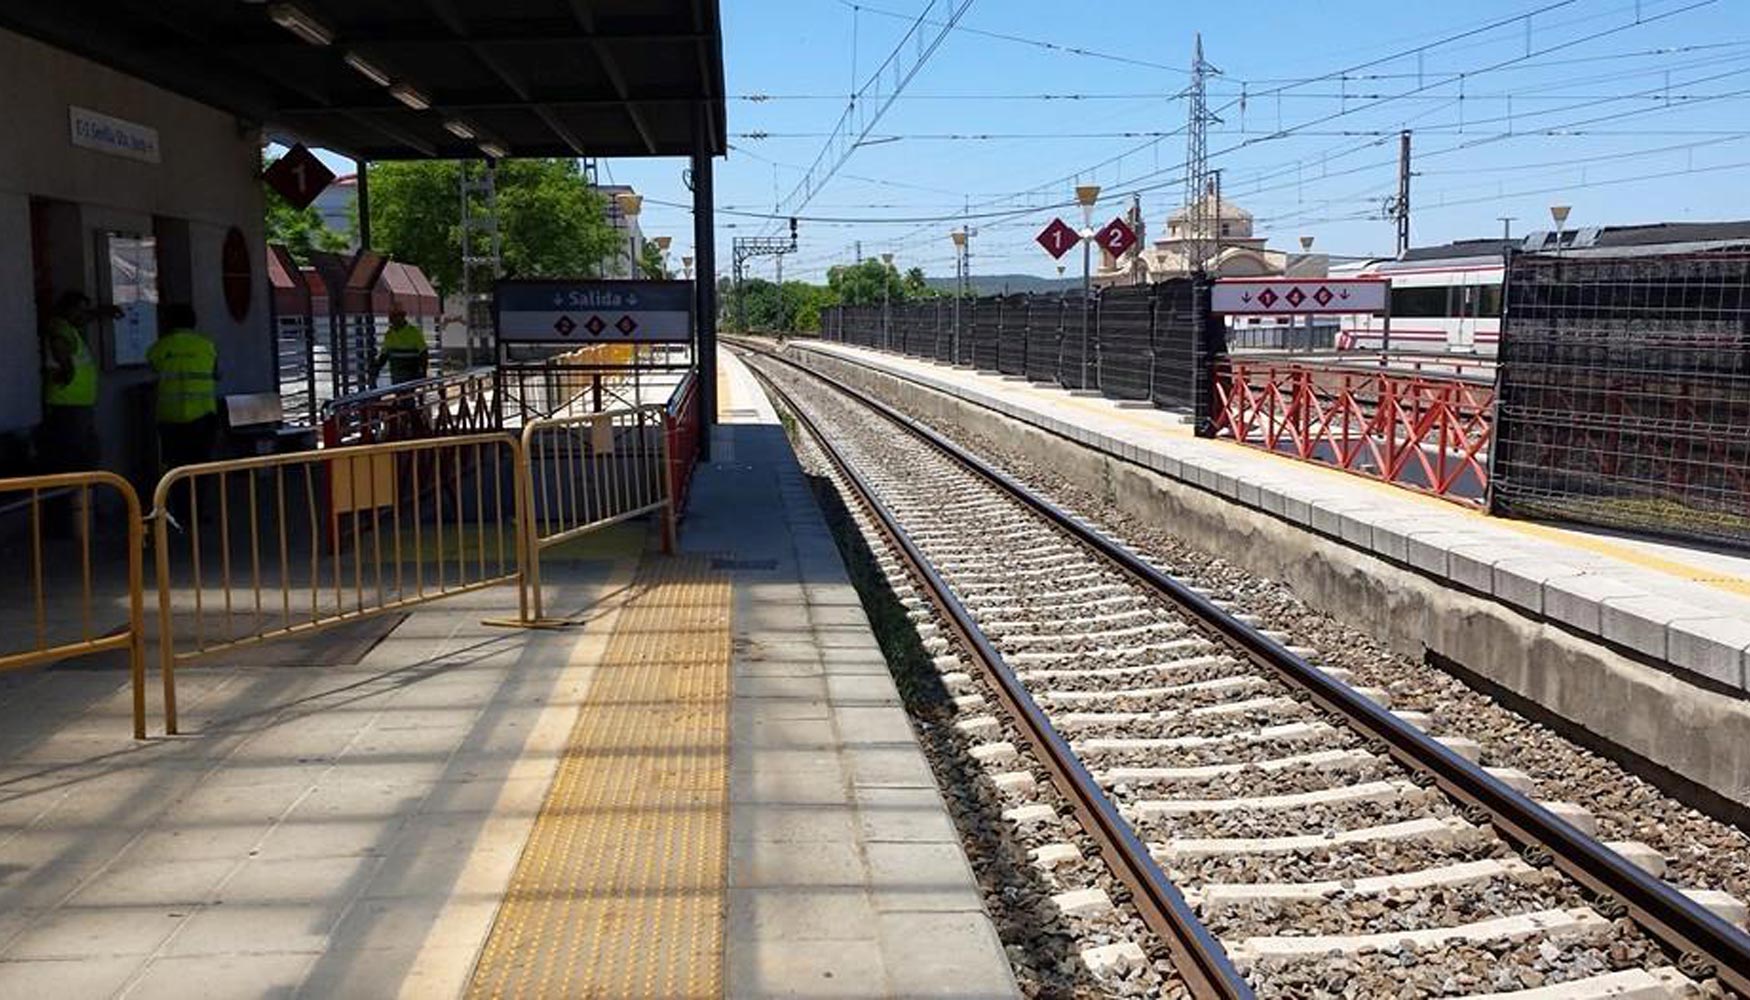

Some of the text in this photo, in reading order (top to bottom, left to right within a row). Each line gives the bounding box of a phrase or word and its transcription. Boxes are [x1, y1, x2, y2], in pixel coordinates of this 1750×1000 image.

[291, 163, 306, 193] 1
[1053, 230, 1062, 248] 1
[1108, 229, 1122, 248] 2
[569, 290, 622, 306] Salida
